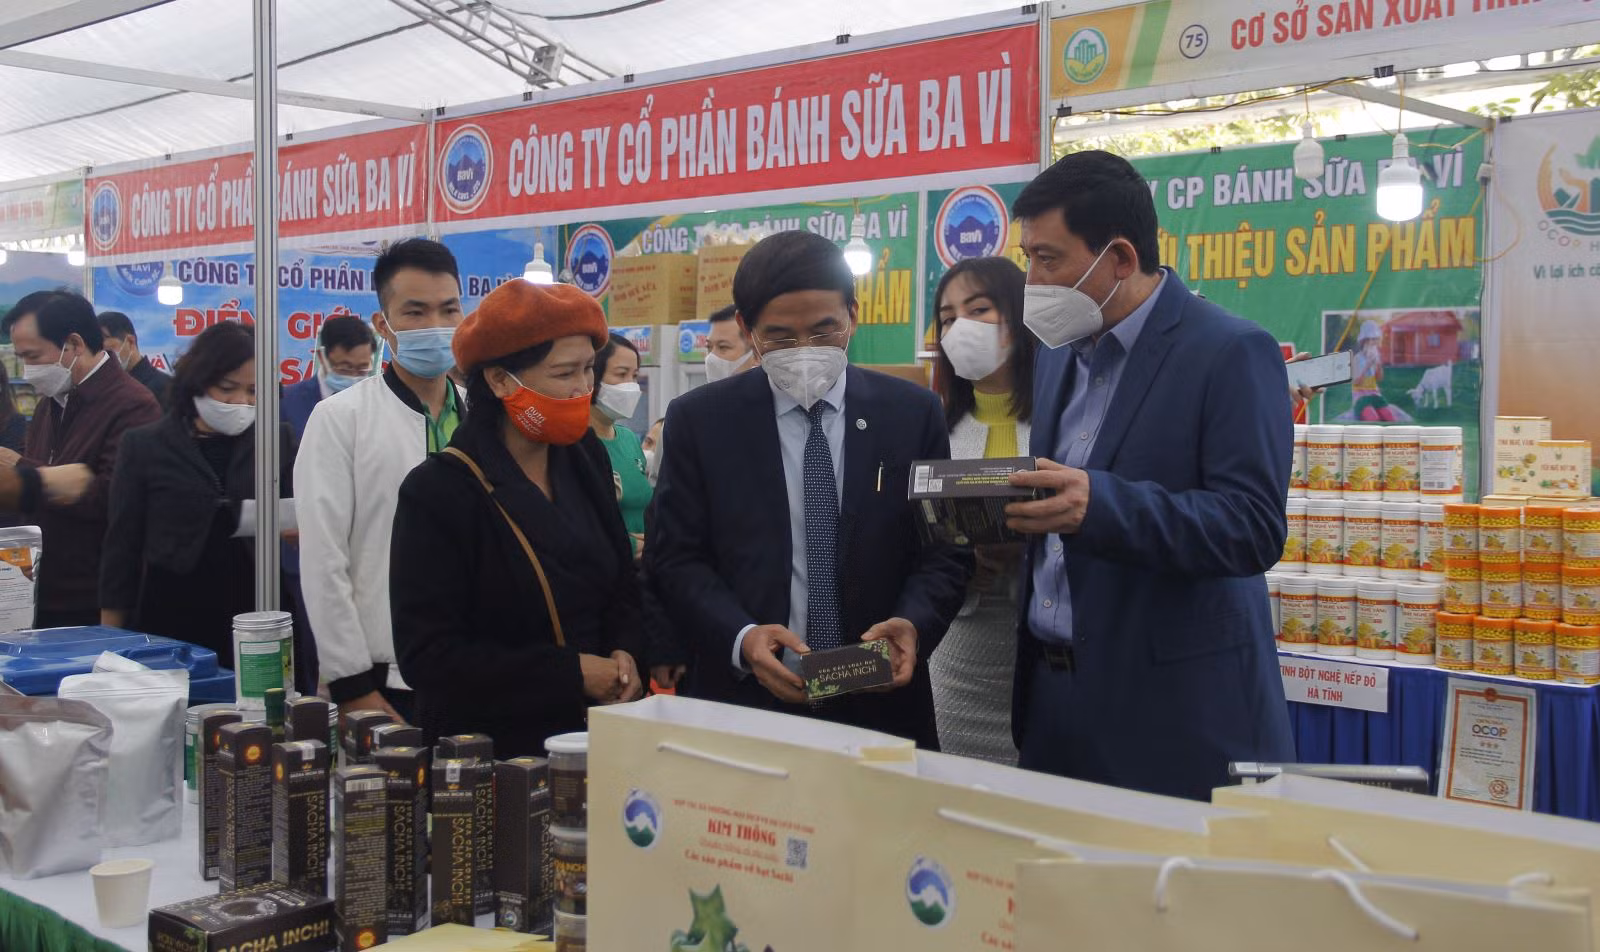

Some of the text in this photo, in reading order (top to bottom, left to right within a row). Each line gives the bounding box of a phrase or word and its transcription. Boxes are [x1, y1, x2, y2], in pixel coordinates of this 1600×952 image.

[1185, 33, 1204, 49] 75
[1231, 12, 1266, 50] CƠ
[508, 51, 1012, 198] CÔNG TY CỔ PHẦN BÁNH SỮA BA VÌ
[131, 142, 417, 239] CÔNG TY CỔ PHẦ ÁNH SỮA BA VÌ
[1167, 176, 1204, 210] CP
[1213, 164, 1293, 206] BÁNH
[641, 223, 689, 254] CÔNG
[807, 210, 847, 241] SỮA
[887, 204, 909, 238] VÌ
[1187, 220, 1275, 288] THIỆU
[1285, 208, 1356, 276] SẢN
[1366, 198, 1475, 273] PHẨM
[178, 257, 239, 286] CÔNG
[278, 258, 304, 288] CỔ
[310, 262, 364, 291] PHẦN
[858, 247, 912, 325] HẨM
[819, 664, 877, 682] SACHA INCHI
[1298, 665, 1316, 681] BỘT
[1318, 668, 1342, 685] NGHỆ
[1344, 669, 1361, 685] NẾP
[1307, 685, 1343, 702] HÀ TĨNH
[1472, 723, 1508, 737] OCOP
[307, 795, 318, 879] SACHA INCHI
[394, 806, 406, 851] SACHA
[476, 788, 487, 871] SACHA INCHI
[707, 818, 732, 837] KIM
[736, 824, 777, 847] THÔNG
[451, 818, 464, 904] SACHA INCHI
[283, 919, 330, 947] INCHI
